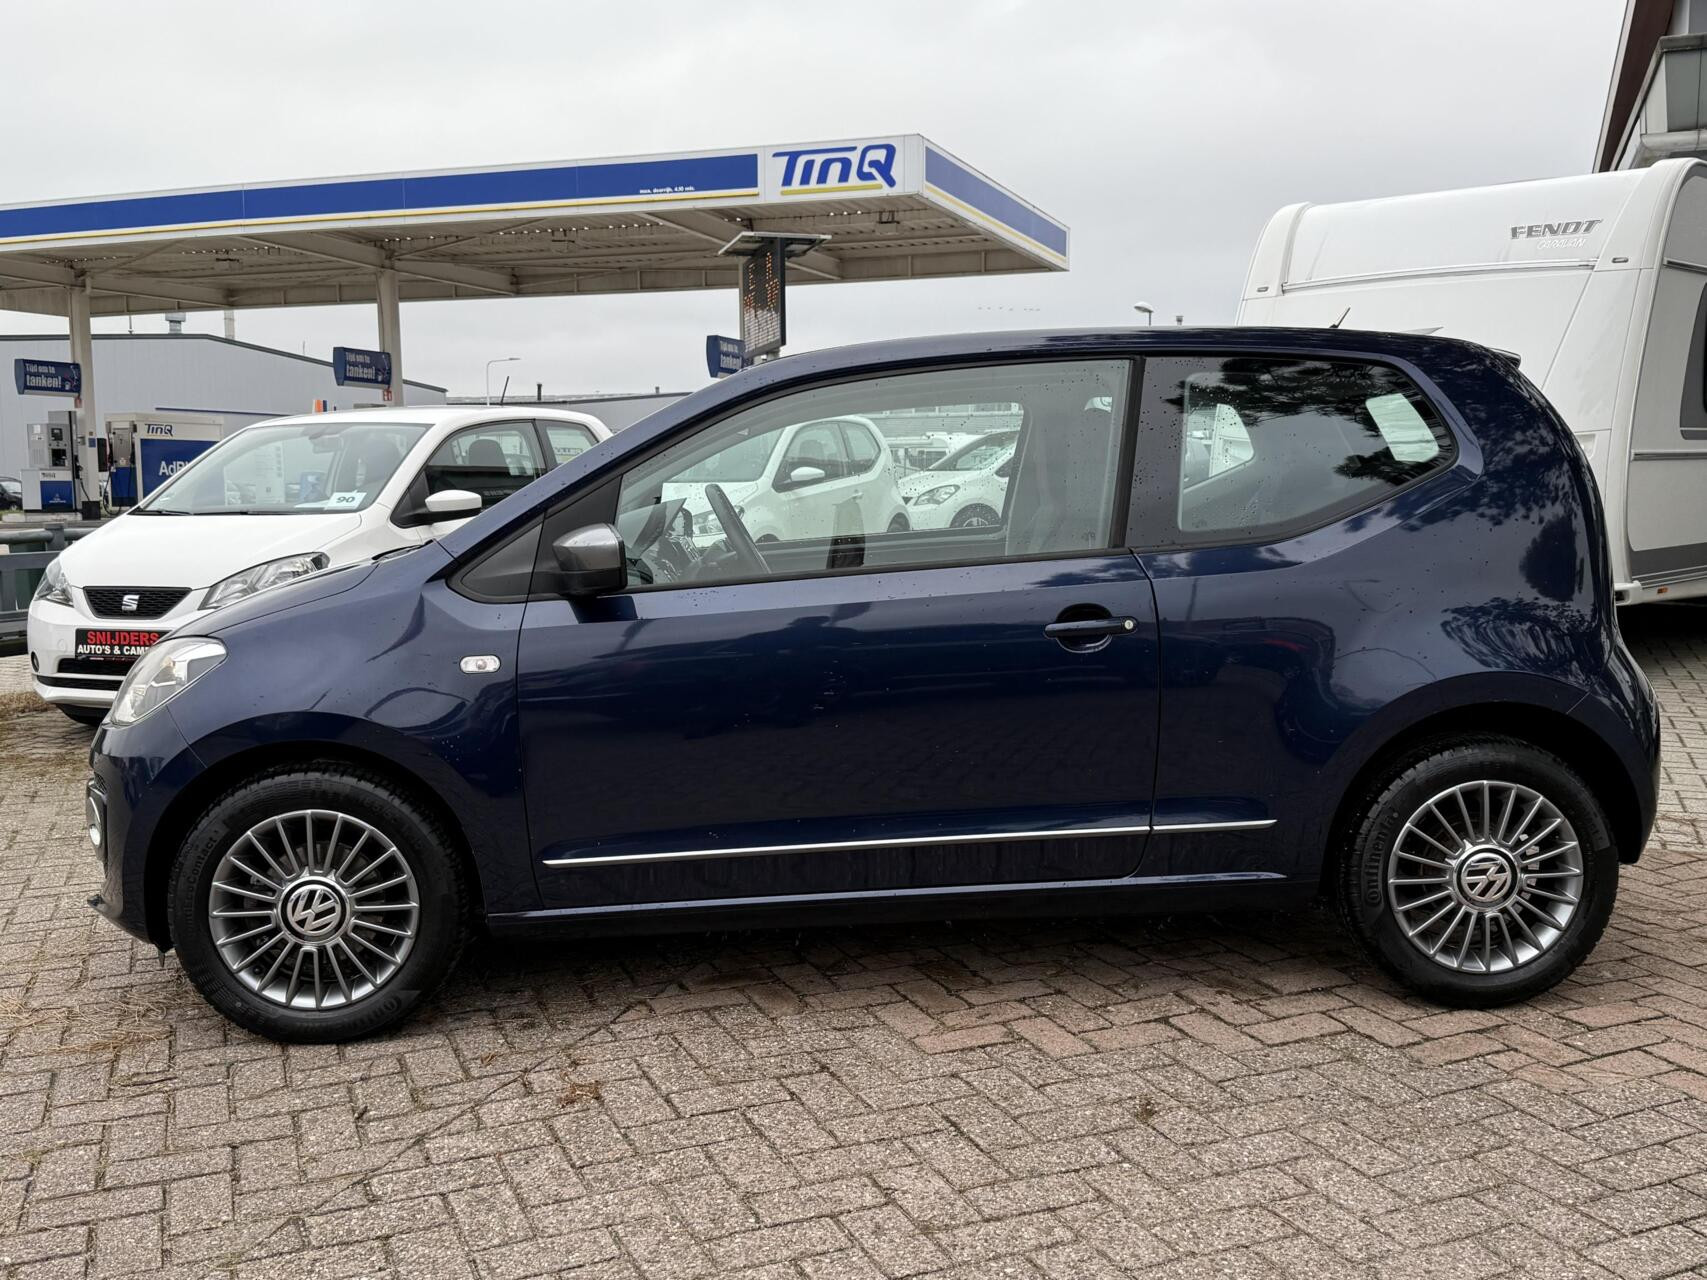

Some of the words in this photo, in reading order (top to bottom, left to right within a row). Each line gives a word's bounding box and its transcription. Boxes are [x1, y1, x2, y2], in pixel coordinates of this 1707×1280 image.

[1511, 219, 1603, 239] FENDT
[346, 364, 376, 380] tanken!
[26, 374, 62, 388] tanken!
[335, 496, 356, 504] 90
[87, 631, 160, 646] SNIJDERS
[77, 644, 111, 654] AUTO'S
[112, 646, 121, 655] &
